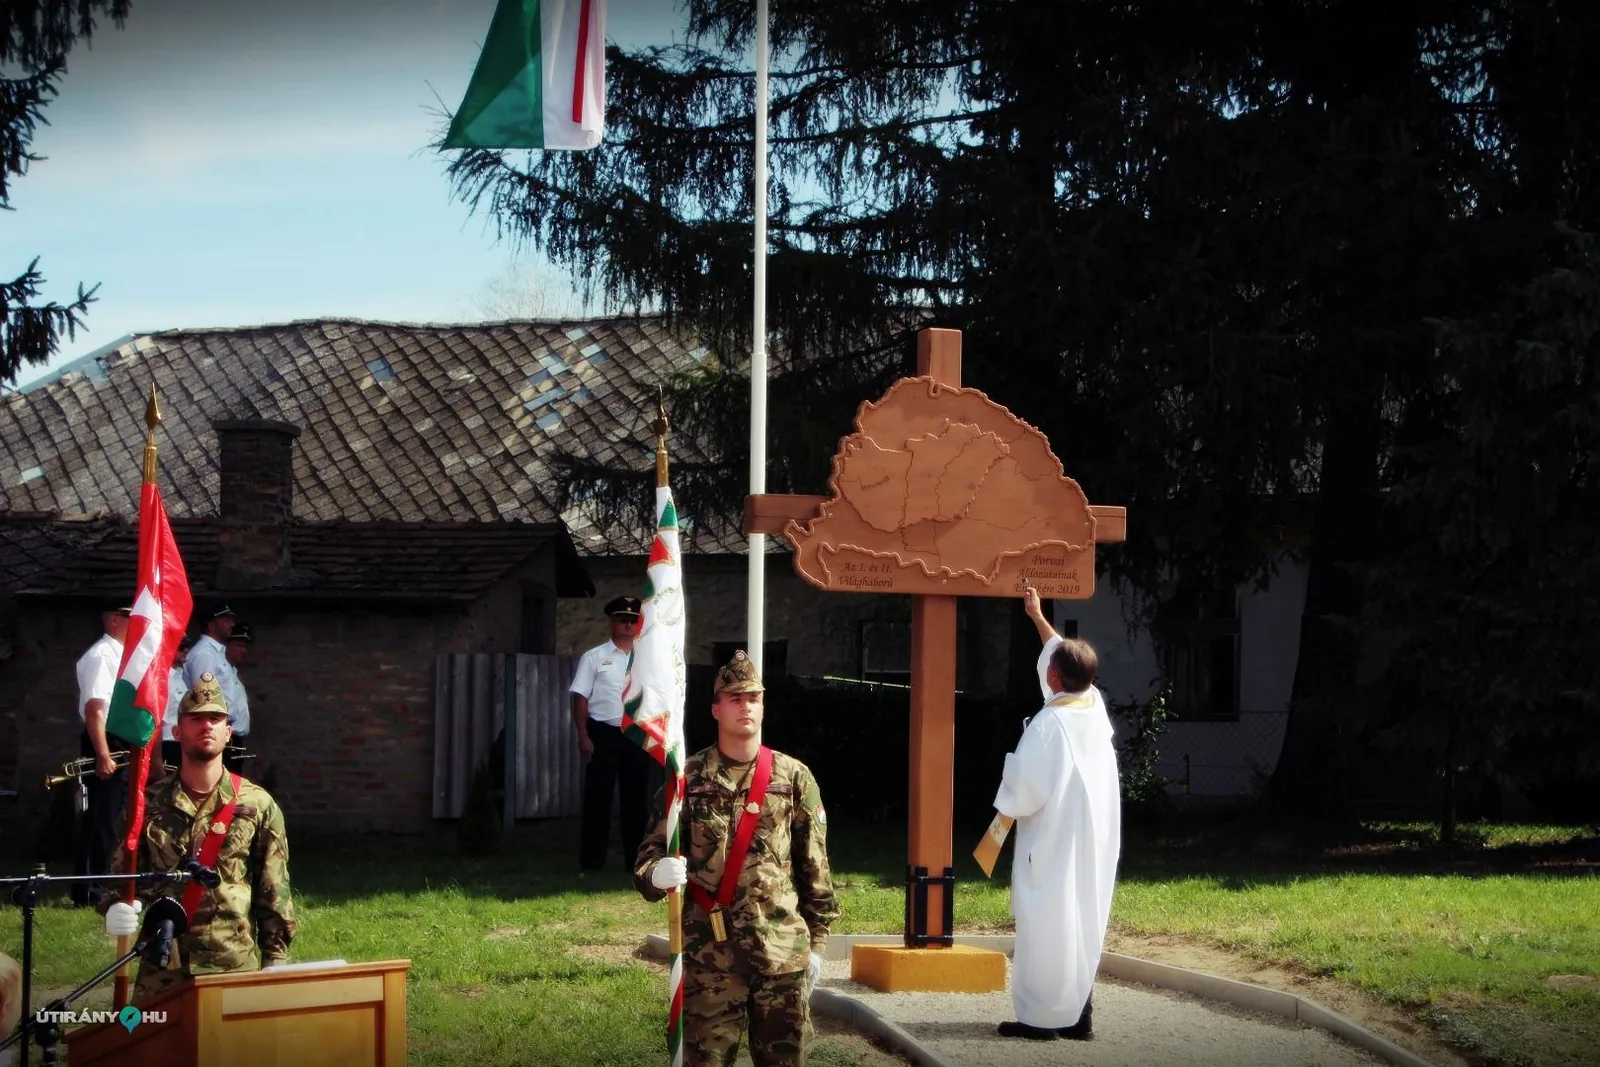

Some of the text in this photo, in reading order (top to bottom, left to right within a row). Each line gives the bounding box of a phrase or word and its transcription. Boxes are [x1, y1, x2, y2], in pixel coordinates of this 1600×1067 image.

[841, 562, 857, 573] Az
[869, 563, 879, 572] és
[1057, 584, 1081, 594] 2019
